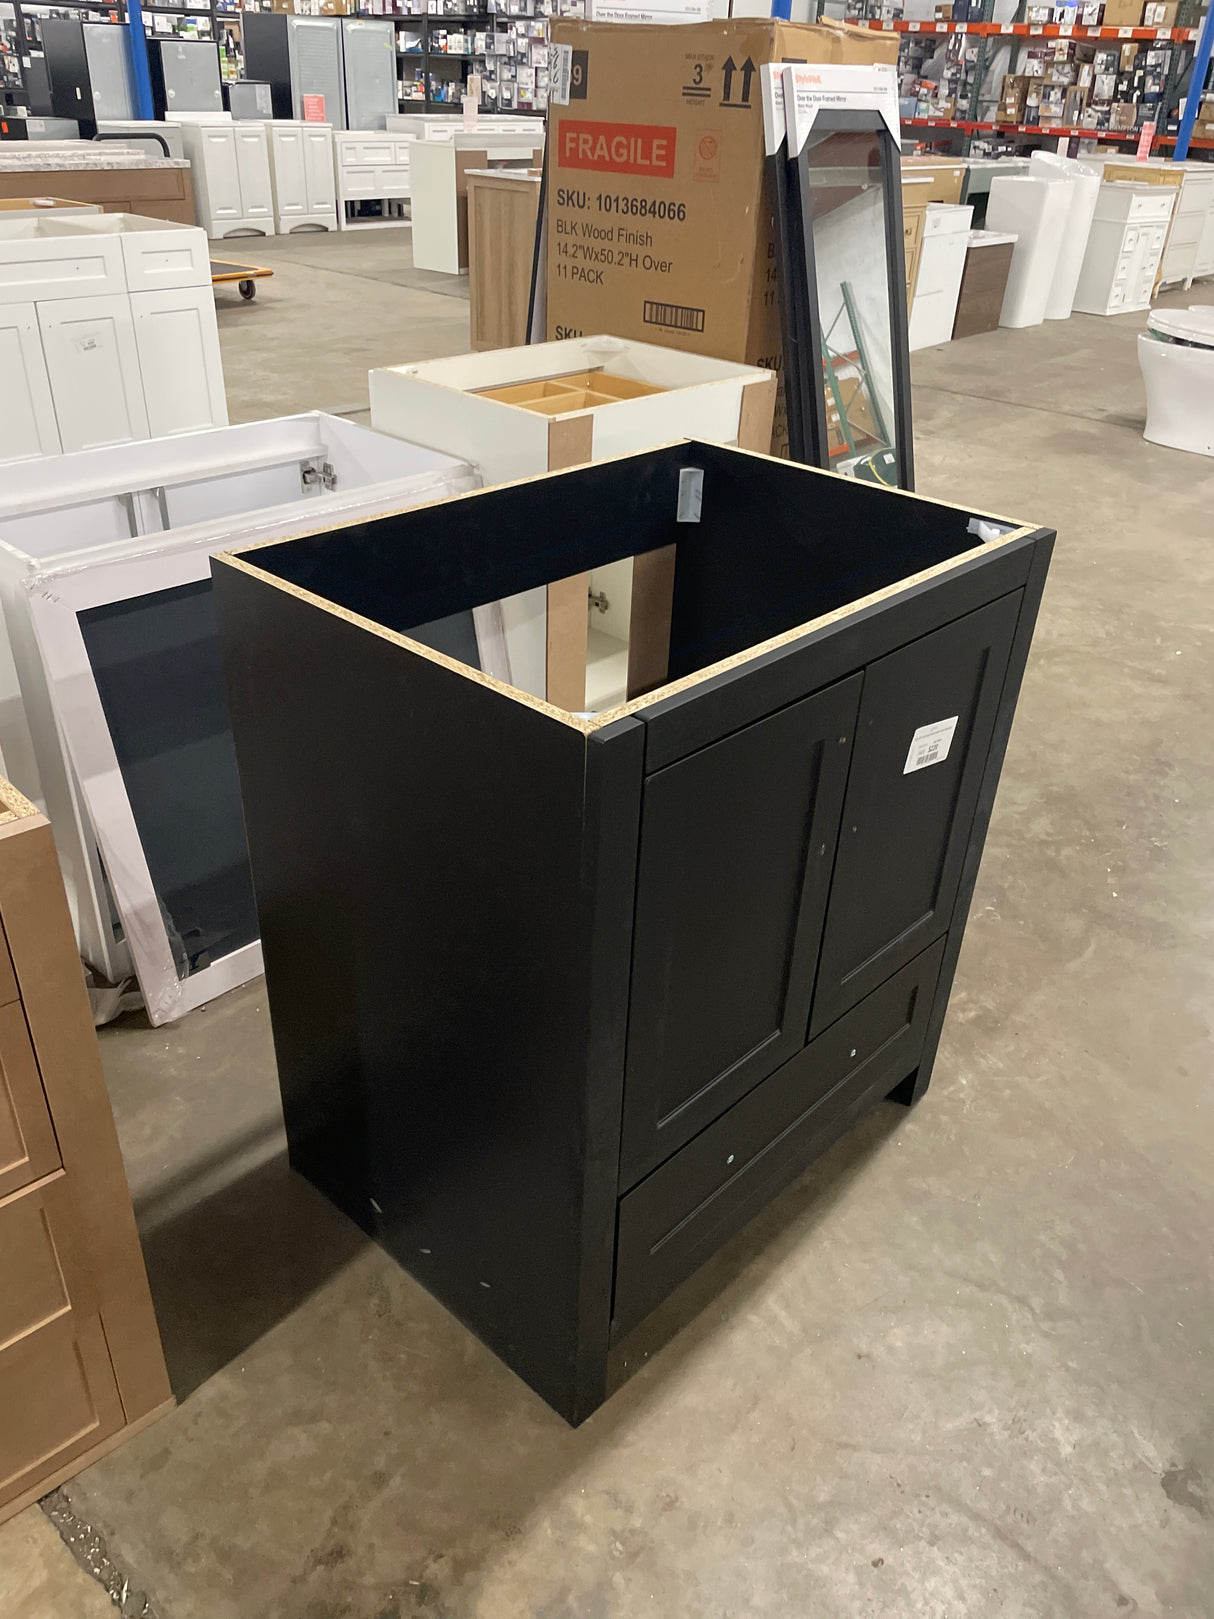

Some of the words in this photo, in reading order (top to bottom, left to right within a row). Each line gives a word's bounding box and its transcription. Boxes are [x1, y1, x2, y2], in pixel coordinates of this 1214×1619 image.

[692, 63, 704, 86] 3
[565, 131, 668, 167] FRAGILE
[556, 188, 591, 210] SKU:
[596, 193, 687, 221] 1013684066
[556, 219, 578, 236] BLK
[581, 222, 614, 242] Wood
[617, 227, 653, 247] Finish
[556, 242, 639, 268] 14.2"Wx50.2"H
[642, 254, 673, 273] Over
[556, 263, 567, 279] 11
[571, 265, 604, 285] PACK
